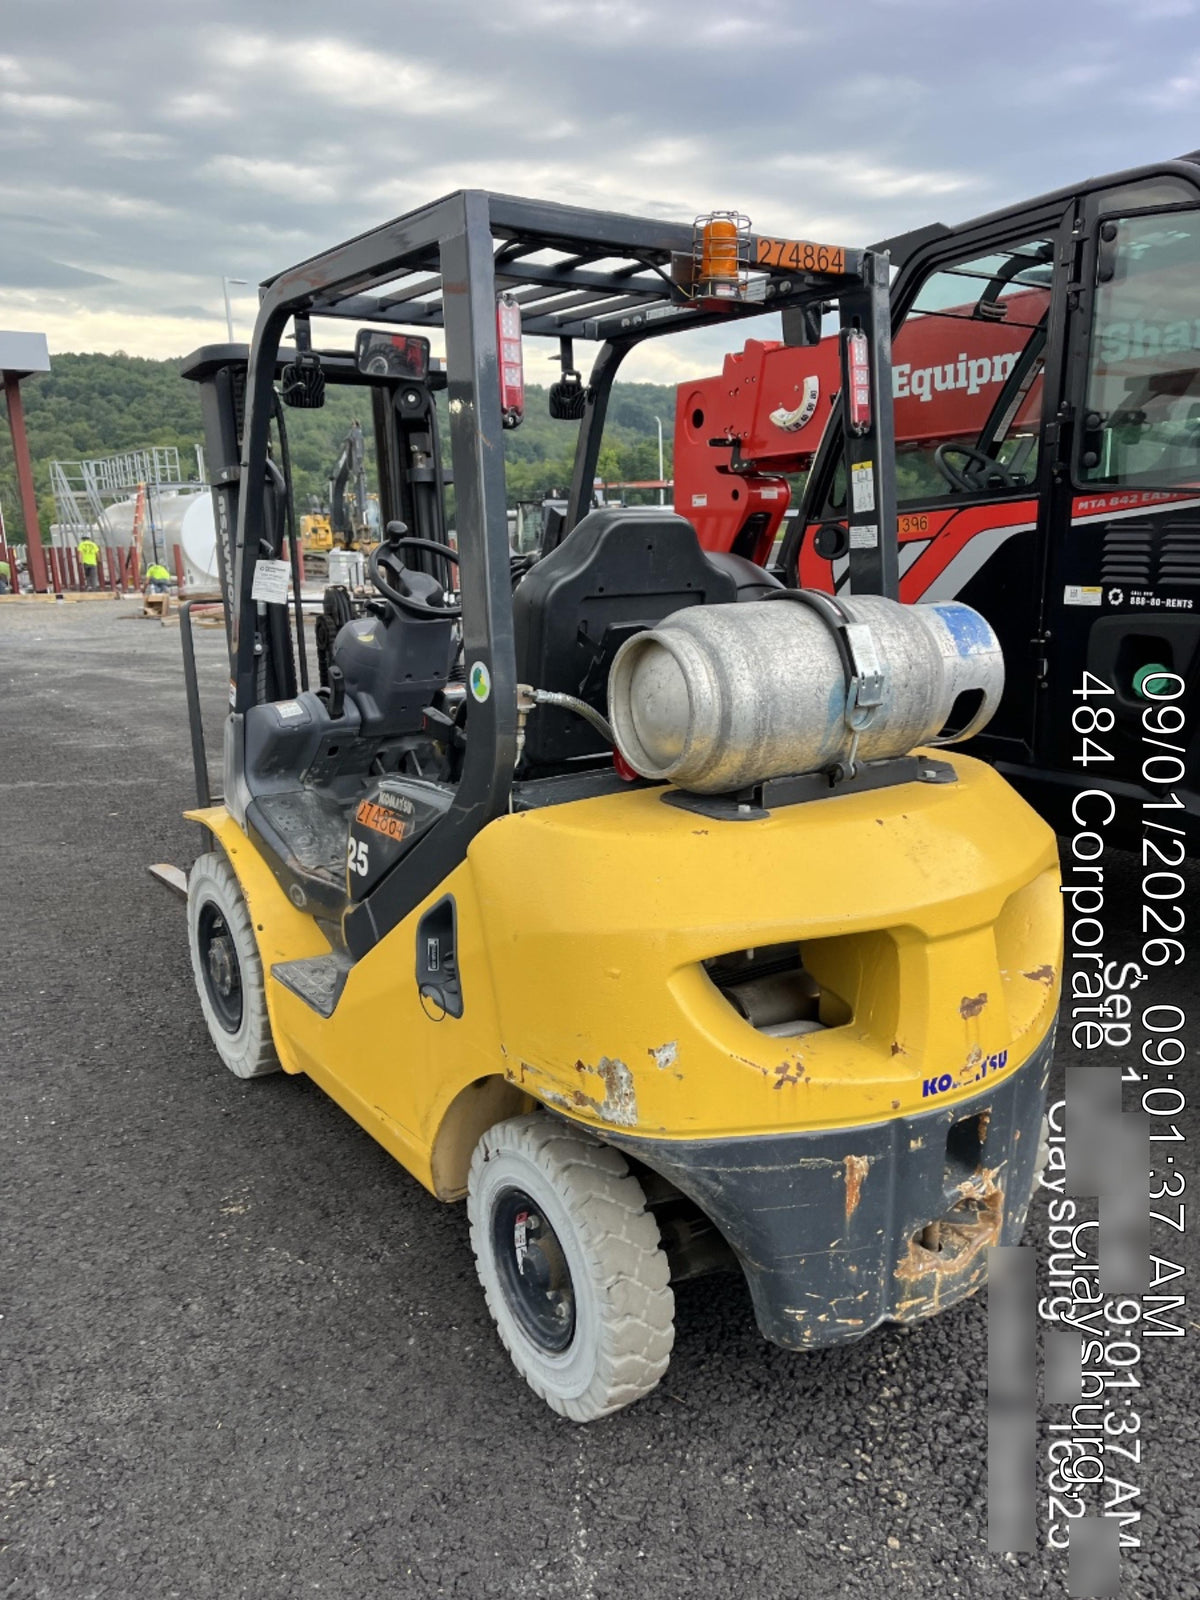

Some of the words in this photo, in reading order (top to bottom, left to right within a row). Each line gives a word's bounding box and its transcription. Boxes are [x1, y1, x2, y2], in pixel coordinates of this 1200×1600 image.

[760, 239, 843, 273] 274864
[1078, 499, 1106, 511] MTA
[1109, 494, 1138, 506] 842
[1130, 597, 1194, 609] 888-80-RENTS
[347, 837, 369, 877] 25
[922, 1049, 1008, 1098] KOTSU
